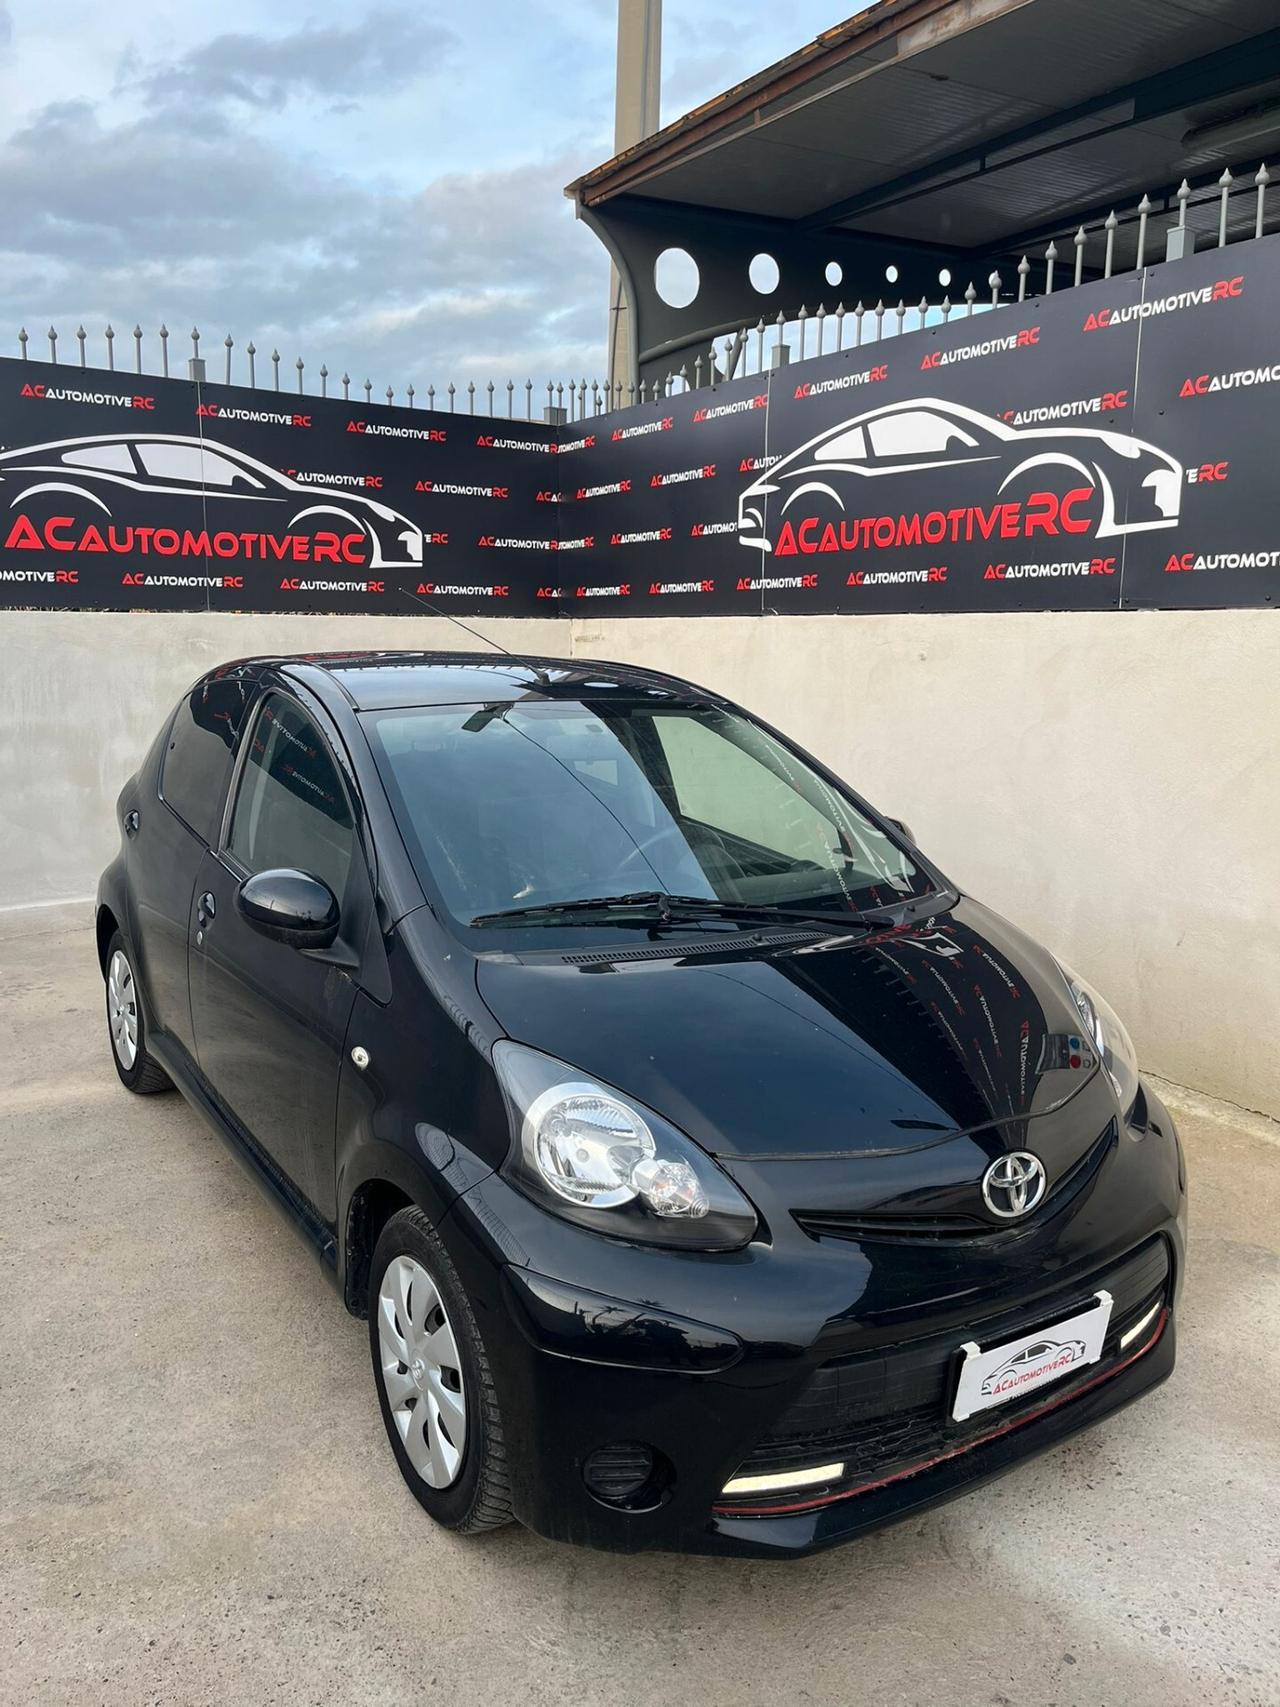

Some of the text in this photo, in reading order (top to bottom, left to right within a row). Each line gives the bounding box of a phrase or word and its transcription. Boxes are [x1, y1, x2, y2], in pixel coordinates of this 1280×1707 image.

[1083, 276, 1244, 332] ACAUTOMOTIVERC
[920, 326, 1041, 371] ACAUTOMOTIVERC
[794, 364, 888, 400] ACAUTOMOTIVERC
[20, 383, 156, 411] ACAUTOMOTIVERC
[693, 393, 768, 423] ACAUTOMOTIVERC
[195, 403, 312, 427] ACAUTOMOTIVERC
[346, 420, 447, 442] ACAUTOMOTIVERC
[611, 416, 673, 442] ACAUTOMOTIVERC
[649, 464, 717, 488] ACAUTOMOTIVERC
[415, 480, 509, 499] ACAUTOMOTIVERC
[576, 479, 632, 500] ACAUTOMOTIVERC
[774, 484, 1093, 556] ACAUTOMOTIVERC
[4, 514, 366, 564] ACAUTOMOTIVERC
[610, 527, 672, 545] ACAUTOMOTIVERC
[0, 570, 79, 584] MOTIVERC
[122, 572, 244, 589] ACAUTOMOTIVERC
[847, 566, 948, 587] ACAUTOMOTIVERC
[983, 557, 1117, 581] ACAUTOMOTIVERC
[280, 577, 385, 593] ACAUTOMOTIVERC
[416, 583, 509, 597] ACAUTOMOTIVERC
[576, 583, 631, 598] ACAUTOMOTIVERC
[649, 579, 715, 595] ACAUTOMOTIVERC
[736, 574, 818, 591] ACAUTOMOTIVERC
[993, 1353, 1072, 1395] ACAUTOMOTIVERC
